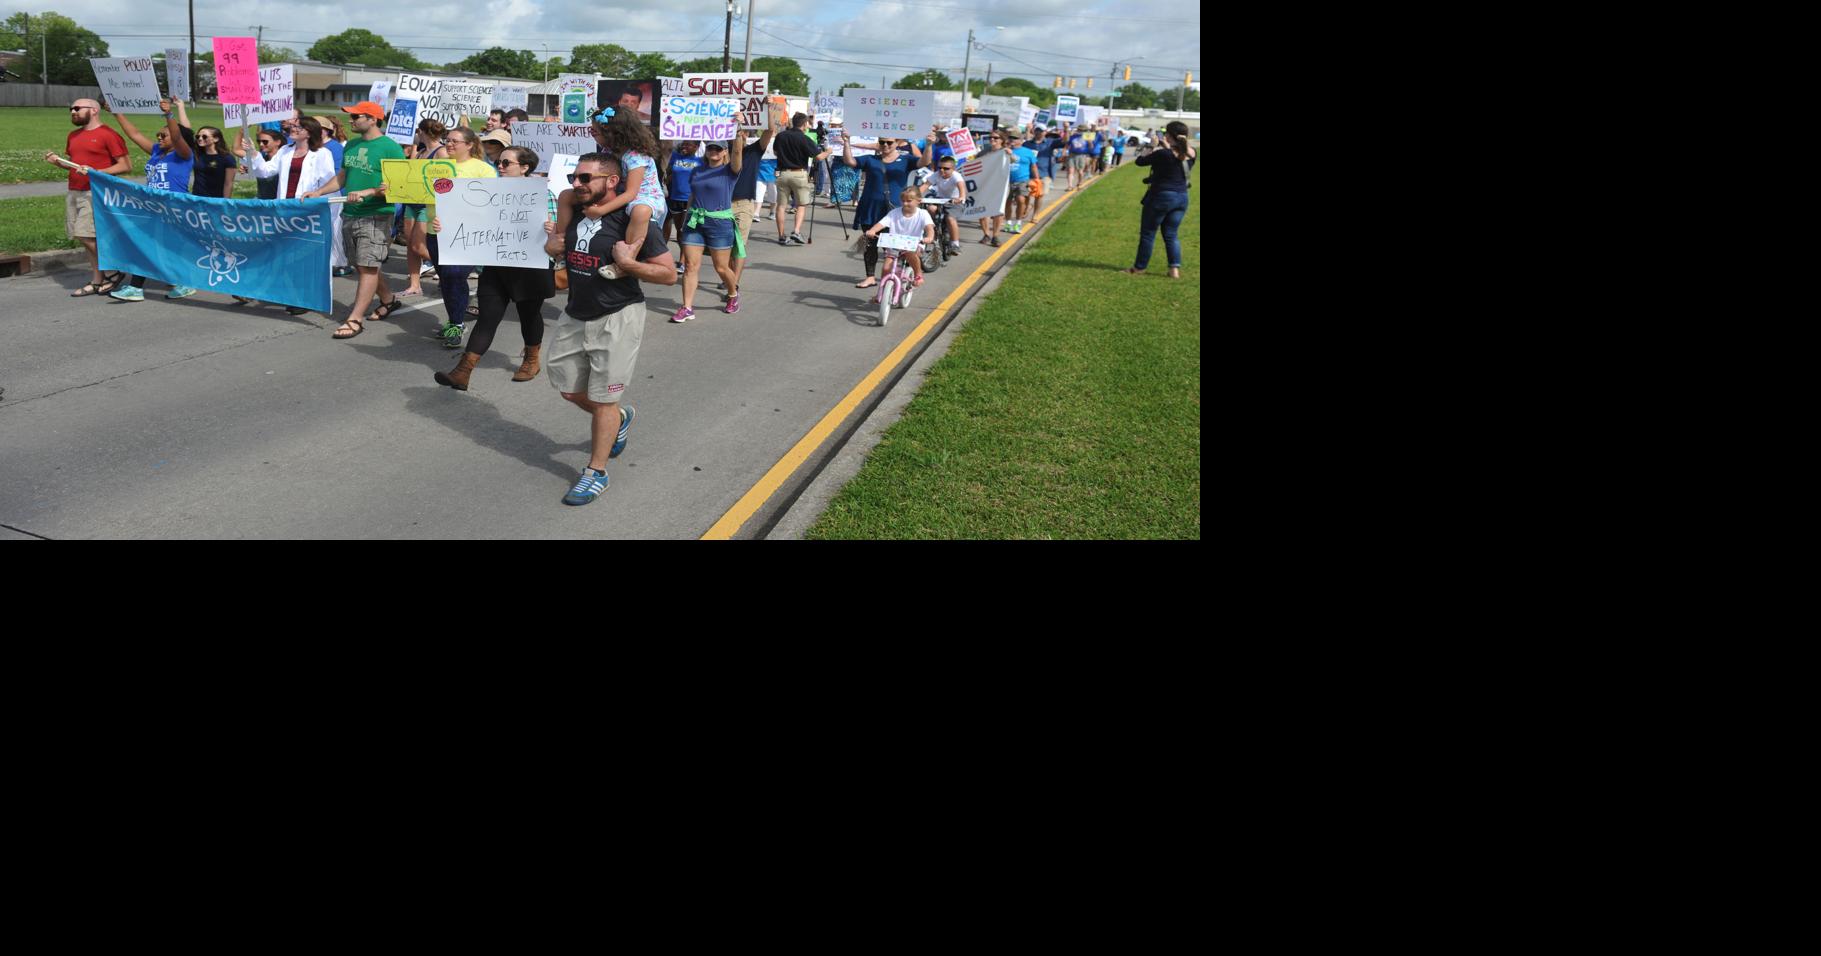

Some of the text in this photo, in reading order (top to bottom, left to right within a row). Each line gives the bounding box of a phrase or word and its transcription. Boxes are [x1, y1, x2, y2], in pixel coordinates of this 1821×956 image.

[222, 52, 240, 64] 99
[123, 59, 152, 72] POLIO?
[277, 81, 292, 92] THE
[443, 84, 493, 95] SUPPORT SCIENCE
[688, 78, 764, 95] SCIENCE
[261, 96, 293, 115] MARCHING
[452, 94, 481, 104] SCIENCE
[860, 97, 916, 107] SCIENCE
[469, 104, 488, 115] YOU
[669, 97, 737, 118] SCIENCE
[876, 110, 898, 118] NOT
[390, 114, 414, 128] DIG
[684, 116, 706, 124] NOT
[513, 123, 593, 139] WE ARE SMARTER
[861, 122, 915, 132] SILENCE
[552, 141, 581, 155] THIS!
[462, 180, 539, 208] SCIENCE
[171, 207, 216, 231] FOR
[220, 214, 323, 235] SCIENCE
[499, 208, 533, 221] IS NOT
[450, 222, 529, 251] ALTERNATIVE
[496, 244, 528, 261] FACTS
